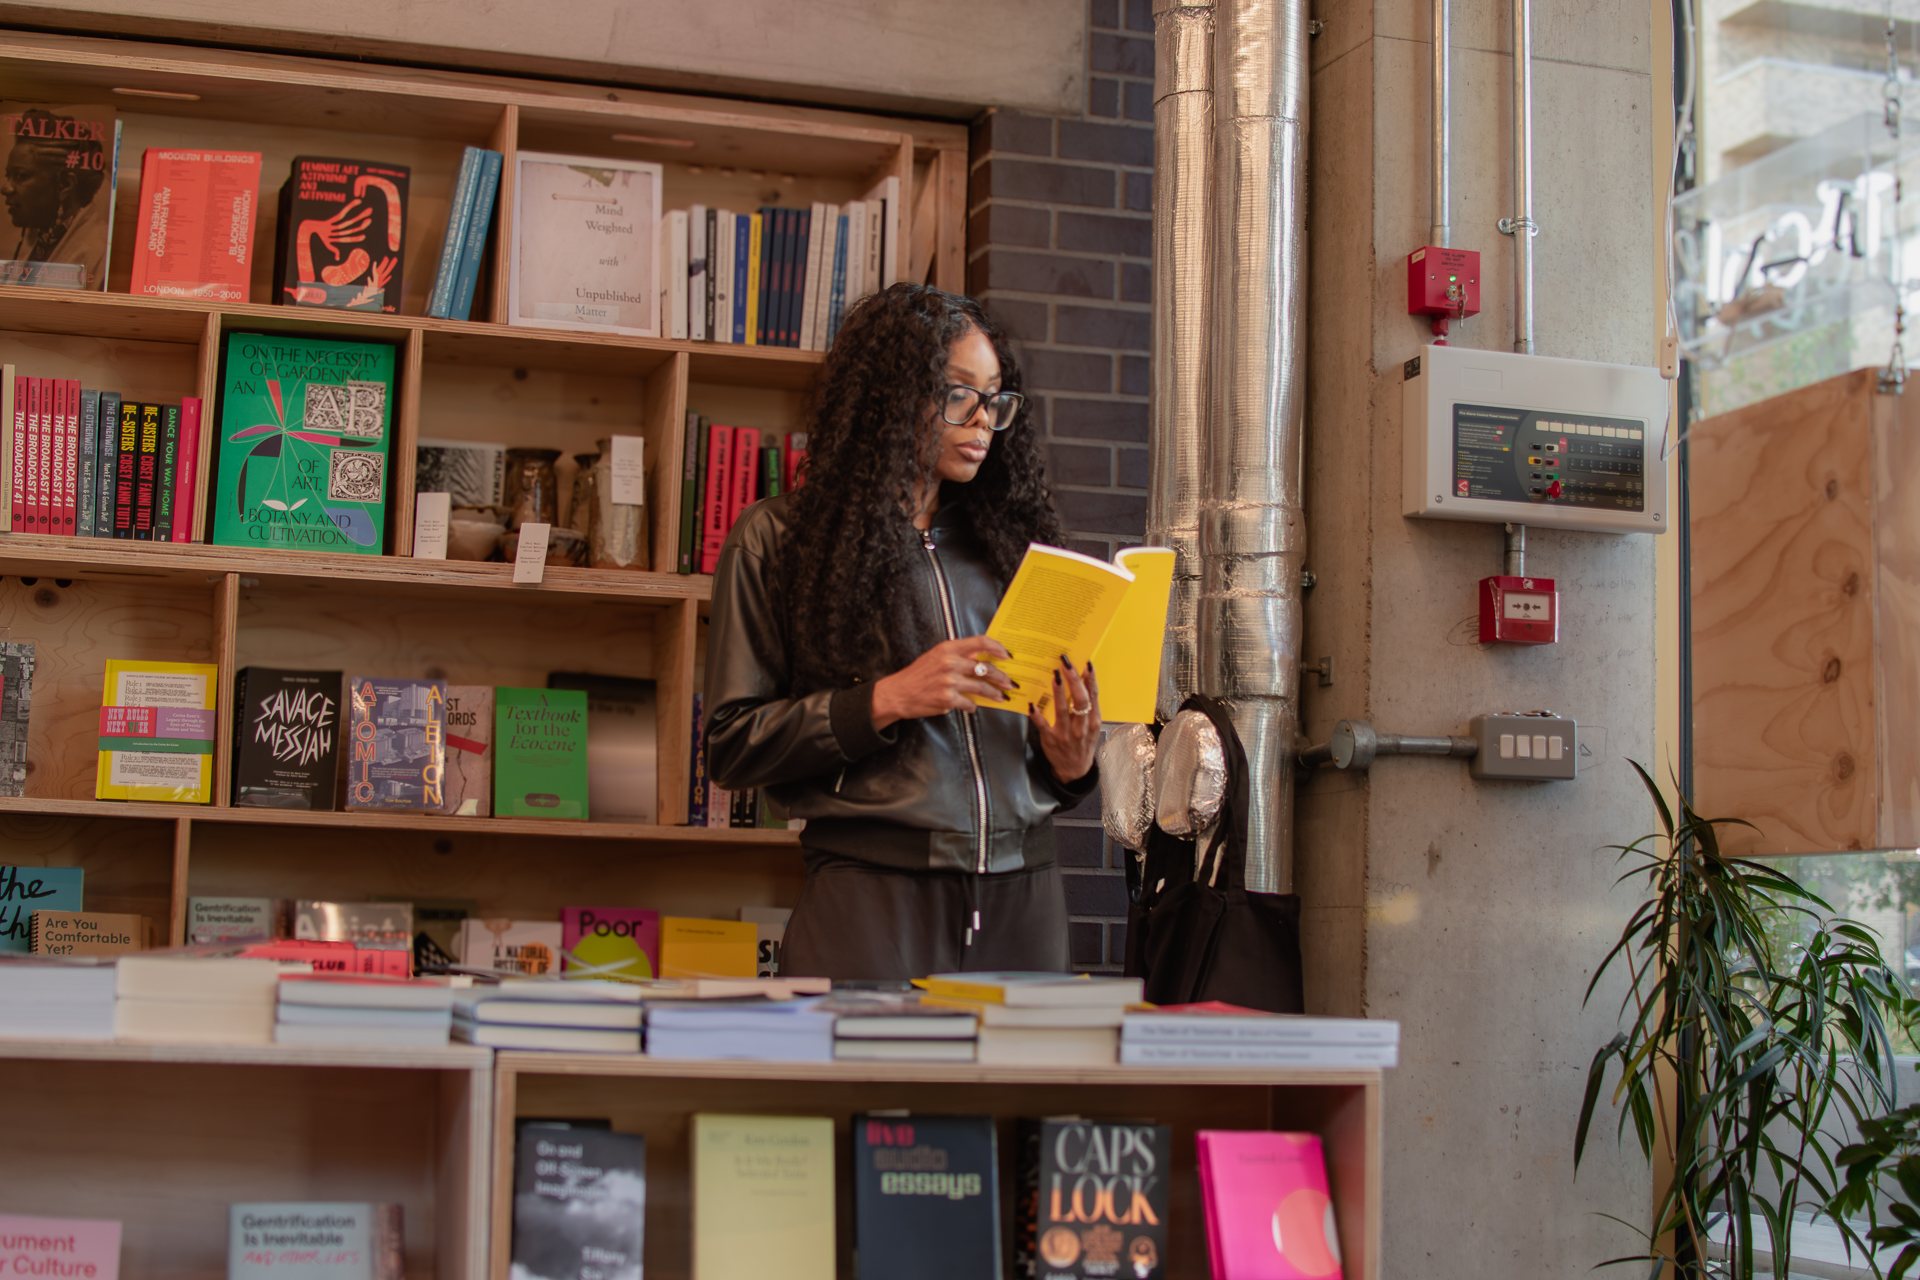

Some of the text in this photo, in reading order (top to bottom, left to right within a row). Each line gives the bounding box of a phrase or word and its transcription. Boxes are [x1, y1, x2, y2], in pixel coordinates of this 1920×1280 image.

[3, 115, 107, 141] TALKER
[66, 151, 104, 170] #10
[159, 152, 254, 164] MODERN BUILDINGS
[595, 204, 623, 217] Mind
[148, 193, 162, 251] SUTHERLAND
[156, 187, 171, 257] ANA FRANCISCO
[229, 197, 242, 255] BLACKHEATH
[237, 190, 252, 264] AND GREENWICH
[585, 220, 633, 235] Weighted
[599, 256, 619, 267] with
[35, 264, 94, 284] Asante
[144, 285, 185, 295] LONDON
[576, 288, 641, 304] Unpublished
[574, 305, 608, 318] Matter
[242, 344, 381, 368] ON THE NECESSITY
[250, 362, 371, 383] OF GARDENING
[232, 380, 257, 395] AN
[15, 411, 24, 430] THE
[84, 399, 95, 455] THE OTHERWISE
[104, 401, 116, 457] THE OTHERWISE
[14, 431, 24, 491] BROADCAST
[27, 413, 38, 506] THE BROADCAST 41
[40, 413, 51, 507] THE BROADCAST 41
[52, 414, 64, 507] THE BROADCAST 41
[65, 415, 77, 508] THE BROADCAST 41
[119, 453, 133, 478] COSEY
[161, 407, 177, 516] DANCE YOUR WAY HOME
[717, 447, 725, 464] THE
[103, 462, 111, 474] Mark
[139, 455, 155, 481] COSEY
[298, 459, 320, 474] OF
[3, 480, 10, 488] On
[83, 476, 91, 489] Smith
[292, 477, 323, 493] ART,
[715, 468, 724, 502] YOUTH
[740, 470, 749, 504] YOUTH
[13, 491, 23, 504] 41
[82, 494, 90, 510] Graham
[101, 495, 109, 511] Graham
[117, 481, 132, 505] FANNI
[138, 482, 153, 506] FANNI
[81, 510, 90, 520] Duff
[100, 511, 108, 522] Duff
[116, 506, 131, 528] TUTTI
[136, 508, 151, 530] TUTTI
[249, 508, 352, 529] BOTANY AND
[713, 504, 723, 530] CLUB
[248, 525, 349, 545] CULTIVATION
[254, 688, 335, 728] SAVAGE
[536, 693, 549, 707] A
[108, 708, 149, 721] NEW RULES
[507, 706, 581, 723] Textbook
[106, 721, 148, 734] NEXT WEEK
[516, 721, 571, 737] for the
[255, 721, 331, 766] MESSIAH
[356, 682, 377, 802] ATOMIC
[422, 685, 443, 804] ALBION
[509, 735, 577, 752] Ecocene
[0, 867, 57, 901] the
[195, 903, 261, 912] Gentrification
[45, 918, 97, 930] Are You
[196, 914, 254, 923] Is Inevitable
[579, 910, 642, 938] Poor
[45, 931, 130, 944] Comfortable
[45, 944, 73, 955] Yet?
[312, 959, 346, 971] CLUB
[866, 1120, 915, 1147] live
[558, 1143, 583, 1159] and
[873, 1146, 947, 1171] audio
[1055, 1124, 1156, 1177] CAPS
[880, 1172, 981, 1200] essays
[1050, 1172, 1160, 1226] LOCK
[241, 1214, 356, 1230] Gentrification
[244, 1232, 344, 1248] Is Inevitable
